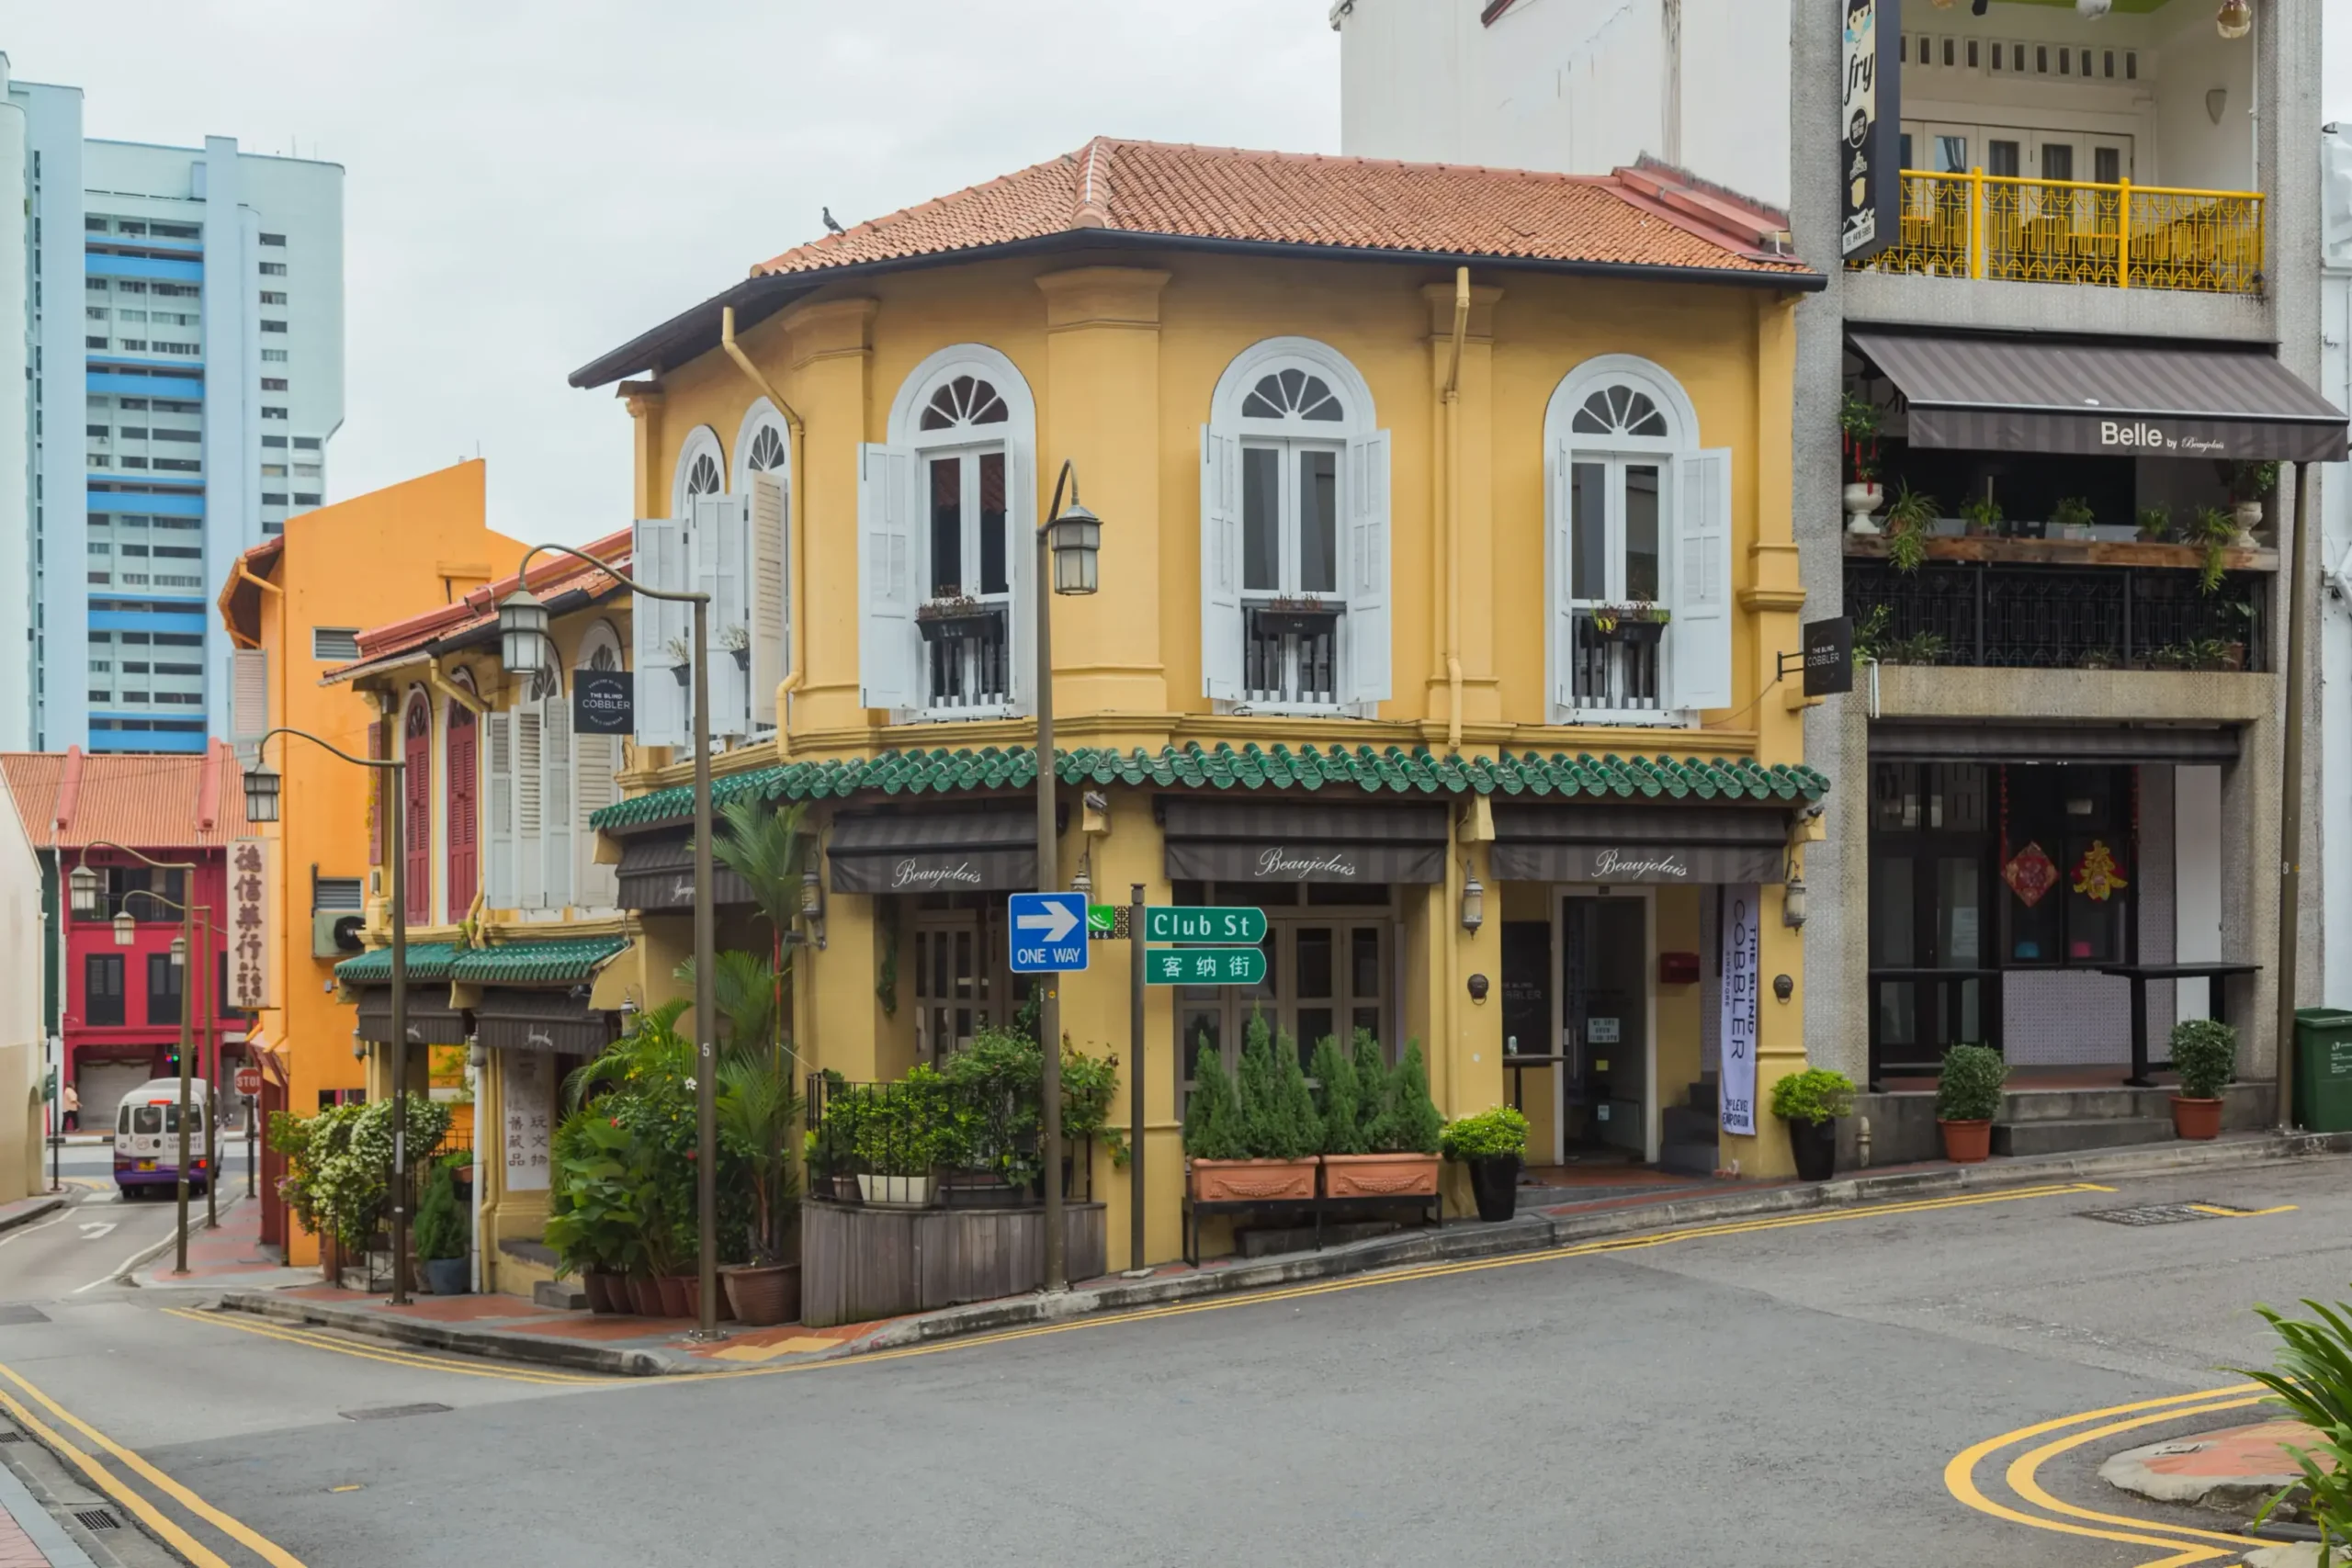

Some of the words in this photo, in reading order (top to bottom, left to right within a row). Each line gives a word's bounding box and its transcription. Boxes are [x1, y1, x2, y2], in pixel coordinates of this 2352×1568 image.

[1843, 52, 1874, 107] fry
[2101, 421, 2163, 447] Belle
[2166, 437, 2177, 450] by
[1807, 652, 1840, 668] COBBLER
[1812, 647, 1821, 655] THE
[1821, 644, 1835, 653] BLIND
[582, 699, 630, 710] COBBLER
[891, 857, 981, 888] Beaujolais
[1254, 845, 1356, 879] Beaujolais
[1591, 848, 1688, 880] Beaujolais
[2282, 861, 2290, 874] 8
[1154, 913, 1212, 936] Club
[1224, 914, 1250, 937] St
[1017, 948, 1046, 964] ONE
[1053, 947, 1081, 964] WAY
[1748, 924, 1757, 964] THE
[1162, 955, 1250, 977] 客纳街
[1731, 898, 1746, 1059] COBBLER
[1747, 972, 1756, 1034] BLIND
[702, 1043, 710, 1057] 5
